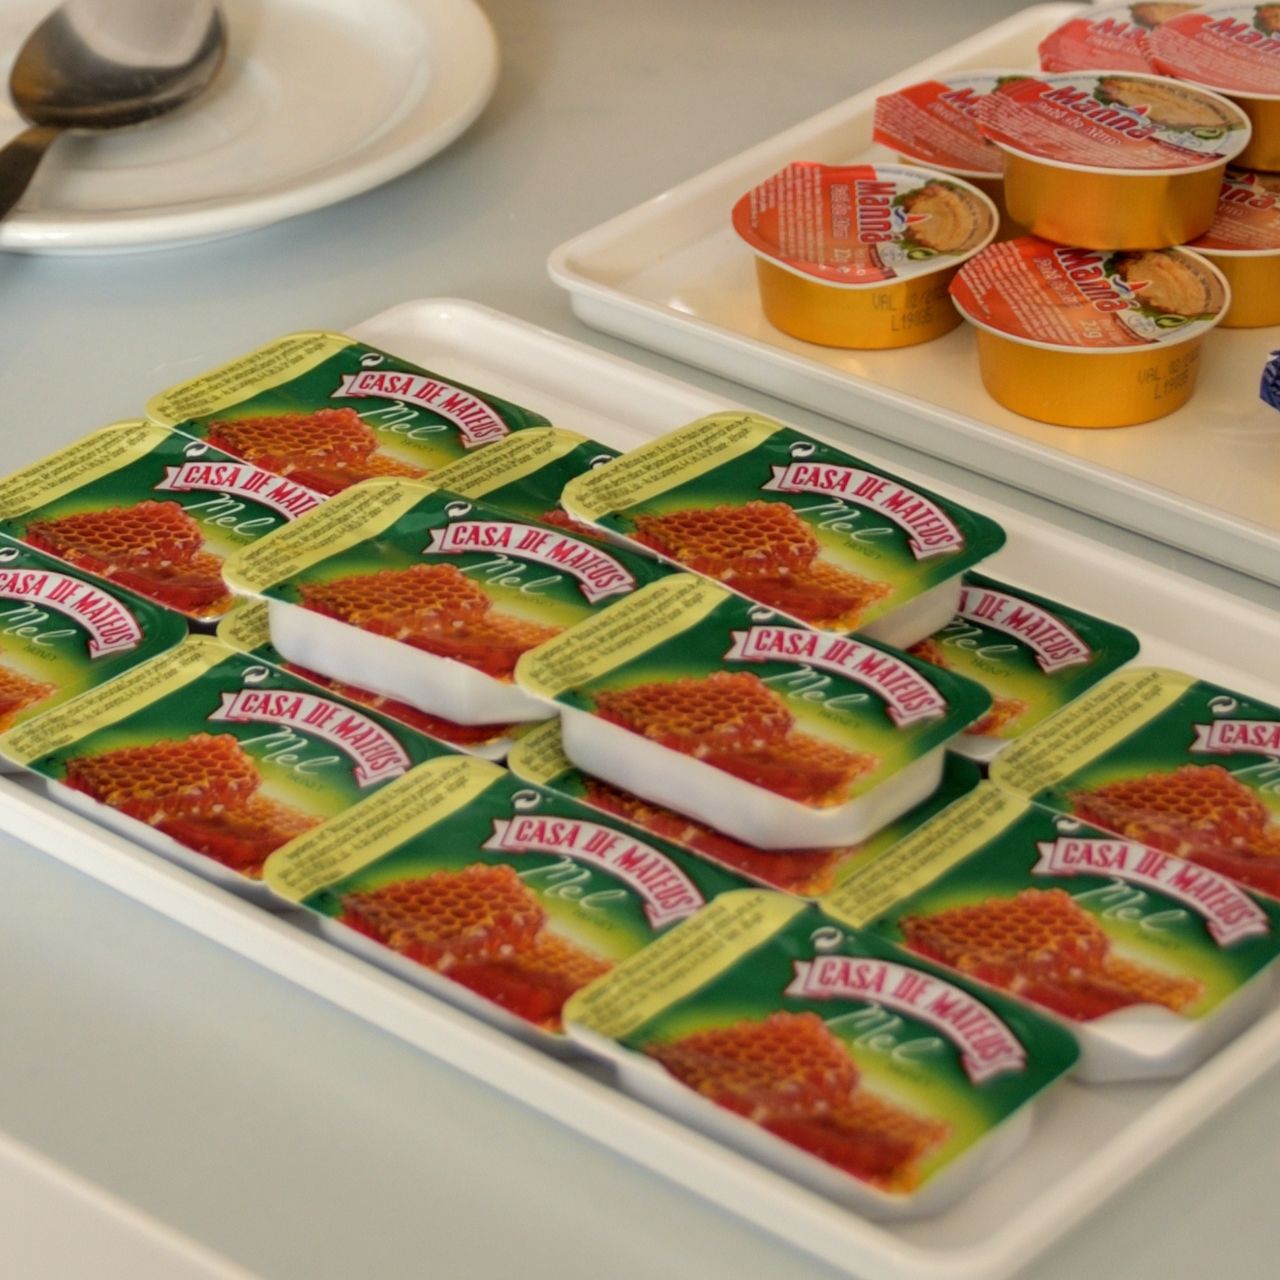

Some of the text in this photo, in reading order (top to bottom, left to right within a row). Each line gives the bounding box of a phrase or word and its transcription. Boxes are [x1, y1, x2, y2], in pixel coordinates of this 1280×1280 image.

[358, 401, 448, 441] Mel
[359, 374, 502, 438] CASA DE MATEUS
[184, 466, 237, 487] CASA
[240, 472, 271, 493] DE
[792, 466, 955, 546] CASA DE MATEUS
[181, 493, 275, 536] Mel
[794, 499, 894, 544] Mel
[452, 525, 625, 588] CASA DE MATEUS
[459, 554, 563, 595] Mel
[45, 578, 83, 603] DE
[70, 590, 135, 644] MATEUS
[971, 593, 1009, 620] DE
[1001, 605, 1080, 661] MATEUS
[754, 629, 936, 712] CASA DE MATEUS
[761, 664, 869, 713] Mel
[238, 725, 340, 775] Mel
[240, 693, 402, 771] CASA DE MATEUS
[516, 820, 695, 910] CASA DE MATEUS
[517, 856, 628, 911] Mel
[1063, 842, 1257, 925] CASA DE MATEUS
[1072, 880, 1188, 932] Mel
[820, 960, 1013, 1060] CASA DE MATEUS
[824, 1004, 944, 1064] Mel
